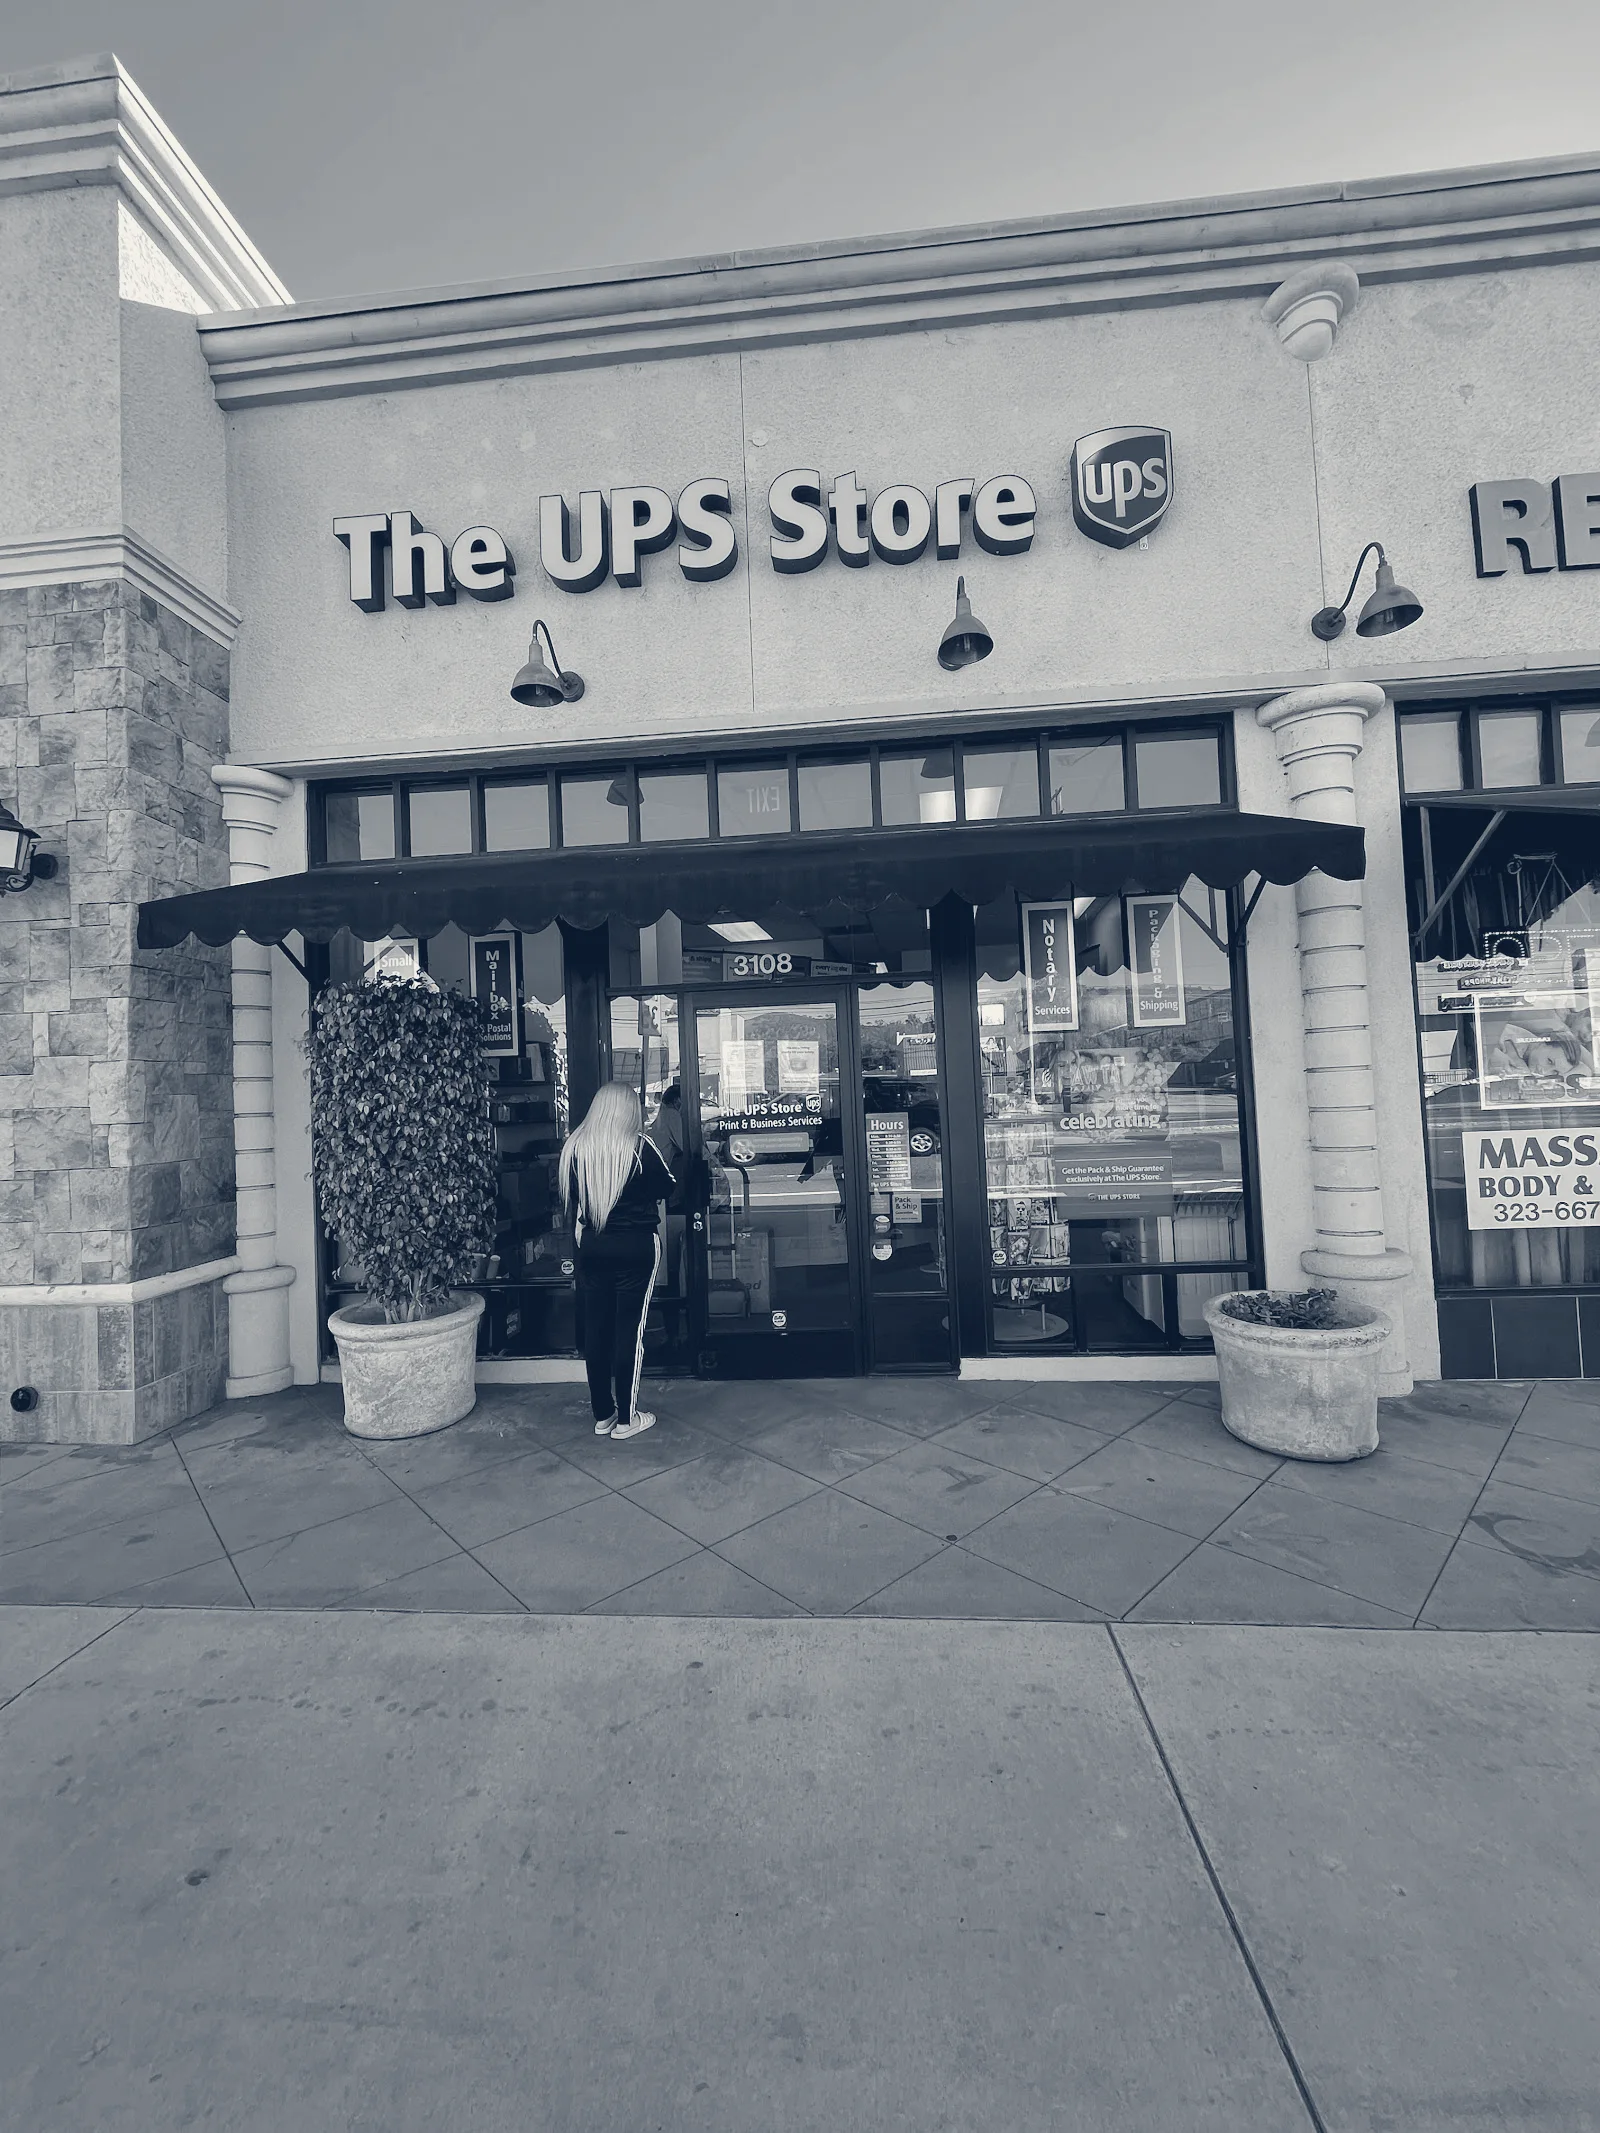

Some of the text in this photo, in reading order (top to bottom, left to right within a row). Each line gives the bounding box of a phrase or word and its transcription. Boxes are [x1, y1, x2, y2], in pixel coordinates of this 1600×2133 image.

[1469, 470, 1600, 578] RE
[332, 468, 1036, 610] The UPS Store
[380, 954, 412, 968] Small
[732, 952, 793, 976] 3108
[1042, 919, 1057, 1003] Notary
[486, 950, 500, 1020] Mailbox
[1154, 987, 1162, 999] &
[1035, 1005, 1071, 1016] Services
[1140, 1000, 1179, 1012] Shipping
[487, 1023, 511, 1033] Postal
[720, 1102, 803, 1117] The UPS Store
[807, 1100, 820, 1111] ups
[719, 1115, 822, 1131] Print & Business Services
[870, 1119, 904, 1131] Hours
[1479, 1135, 1600, 1169] MASS
[1061, 1167, 1074, 1175] Get
[1087, 1166, 1104, 1174] Pack
[1111, 1166, 1127, 1174] Ship
[1066, 1175, 1103, 1184] exclusively
[1126, 1173, 1140, 1181] UPS
[1478, 1174, 1594, 1198] BODY &
[902, 1203, 918, 1211] Ship
